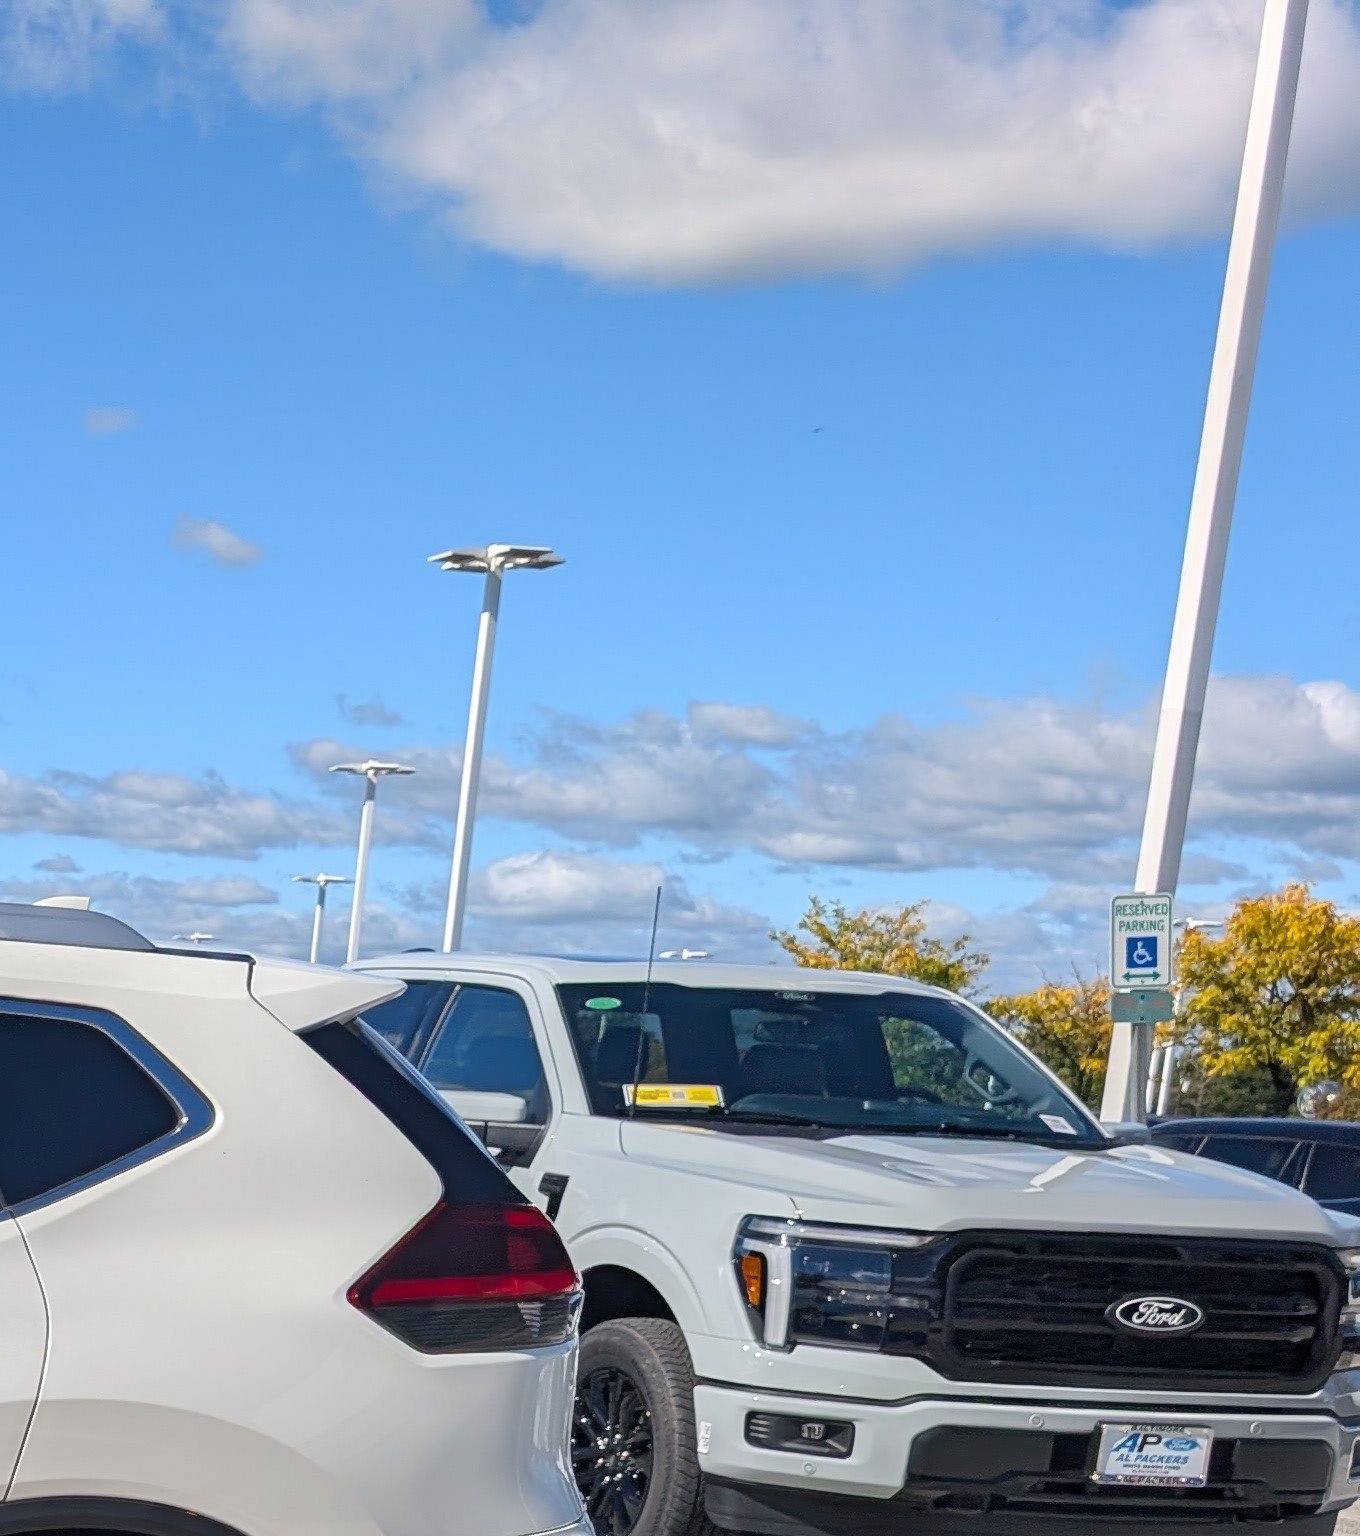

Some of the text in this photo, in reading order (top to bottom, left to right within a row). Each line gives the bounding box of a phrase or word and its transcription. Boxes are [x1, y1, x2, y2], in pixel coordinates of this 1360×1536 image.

[1114, 902, 1169, 917] RESERVED
[1118, 920, 1165, 933] PARKING
[1131, 1301, 1187, 1326] Ford
[1111, 1432, 1162, 1453] AP
[1115, 1453, 1190, 1465] AL PACKERS
